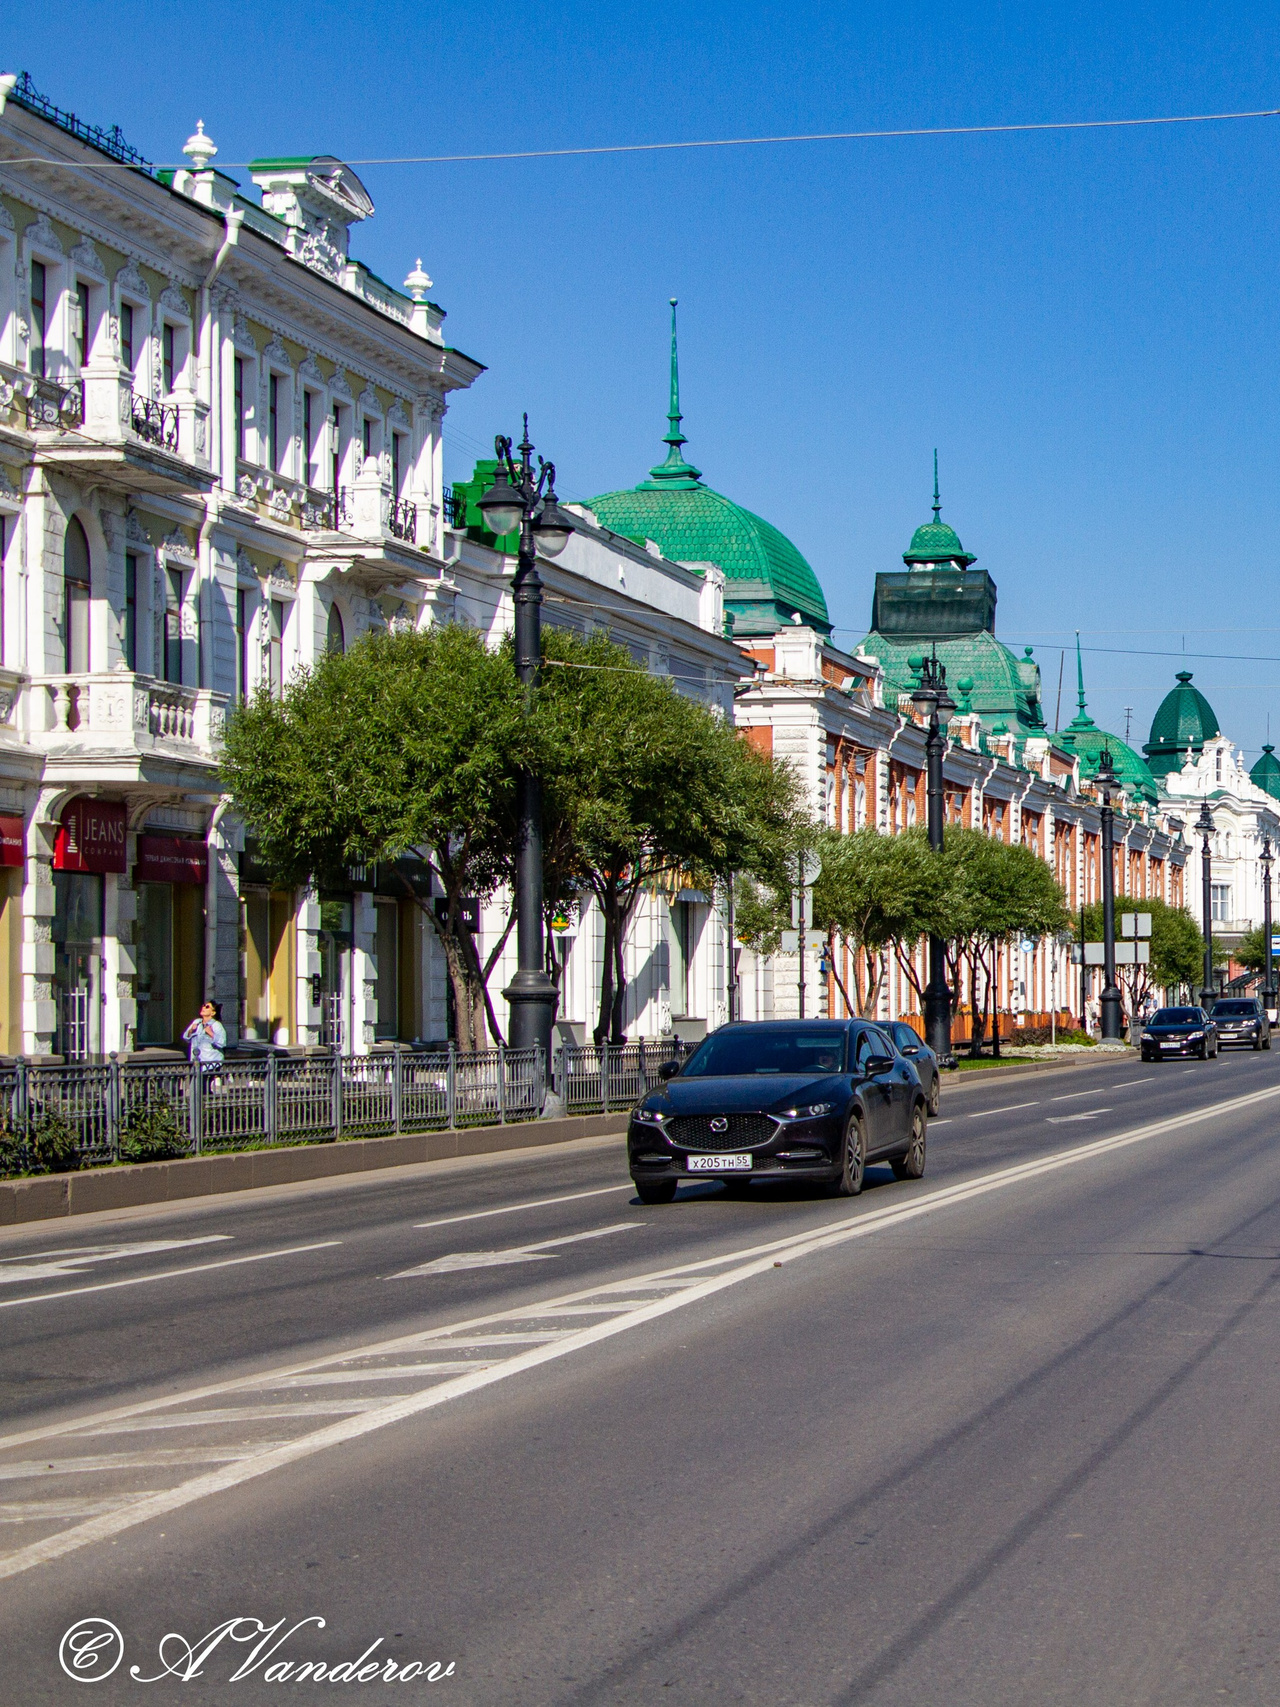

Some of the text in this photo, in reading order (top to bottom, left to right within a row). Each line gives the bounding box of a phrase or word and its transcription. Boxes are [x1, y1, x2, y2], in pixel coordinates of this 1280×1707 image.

[85, 818, 124, 844] JEANS
[84, 846, 123, 856] COMPANY
[736, 1156, 748, 1165] 55
